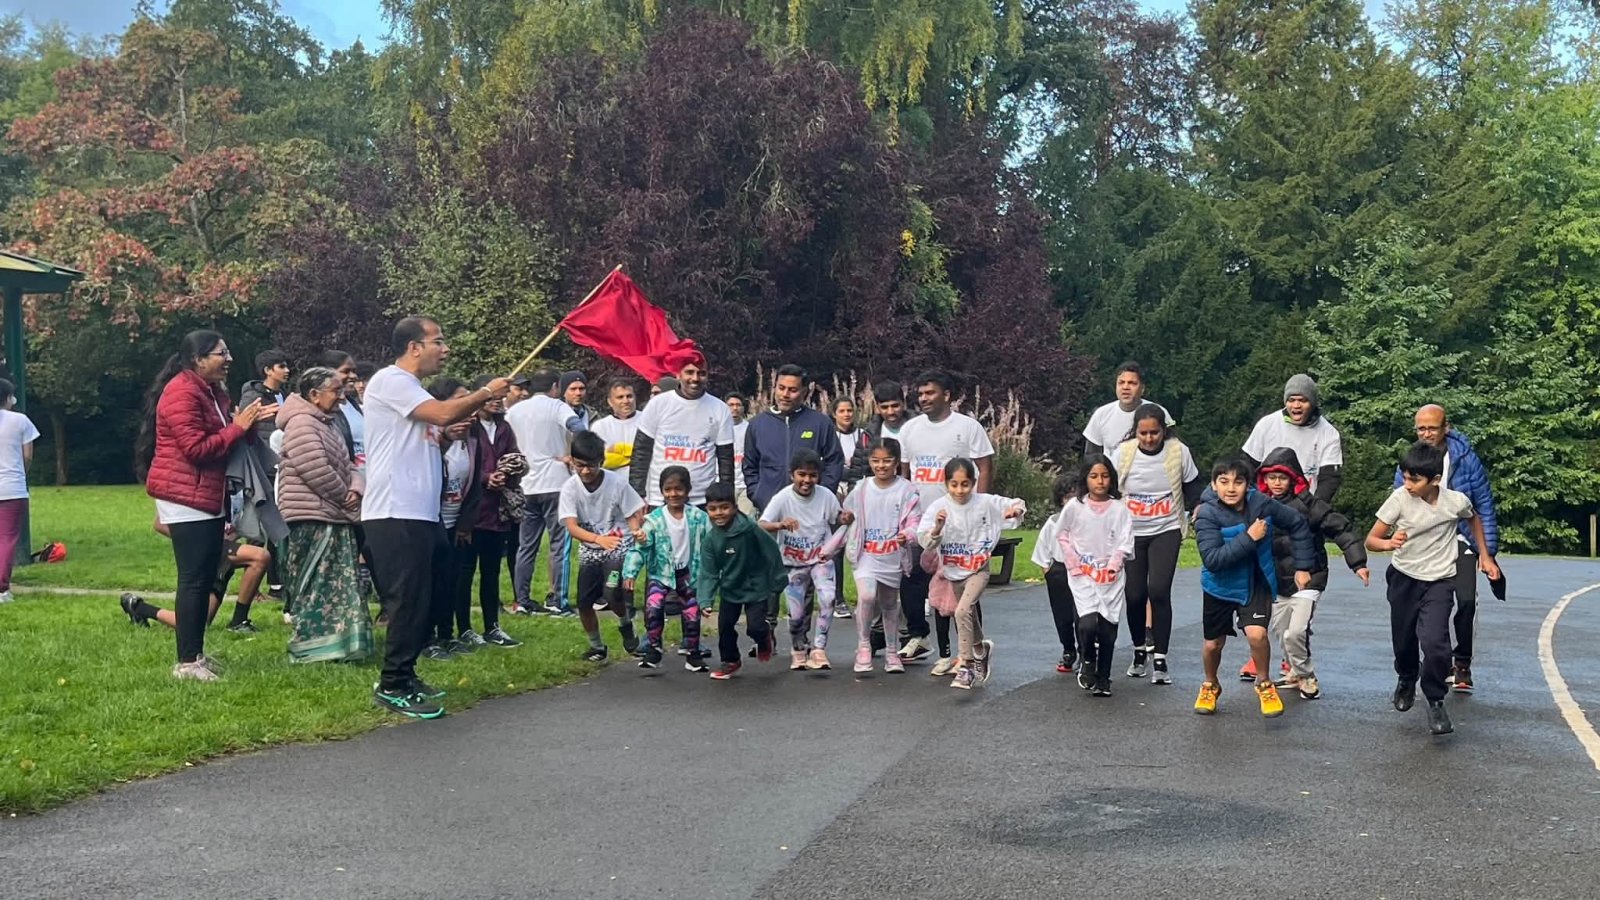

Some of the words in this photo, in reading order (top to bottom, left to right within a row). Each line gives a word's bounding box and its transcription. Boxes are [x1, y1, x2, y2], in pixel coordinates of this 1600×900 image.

[664, 447, 706, 463] RUN
[783, 535, 808, 543] VIKSIT
[940, 542, 967, 550] VIKSIT
